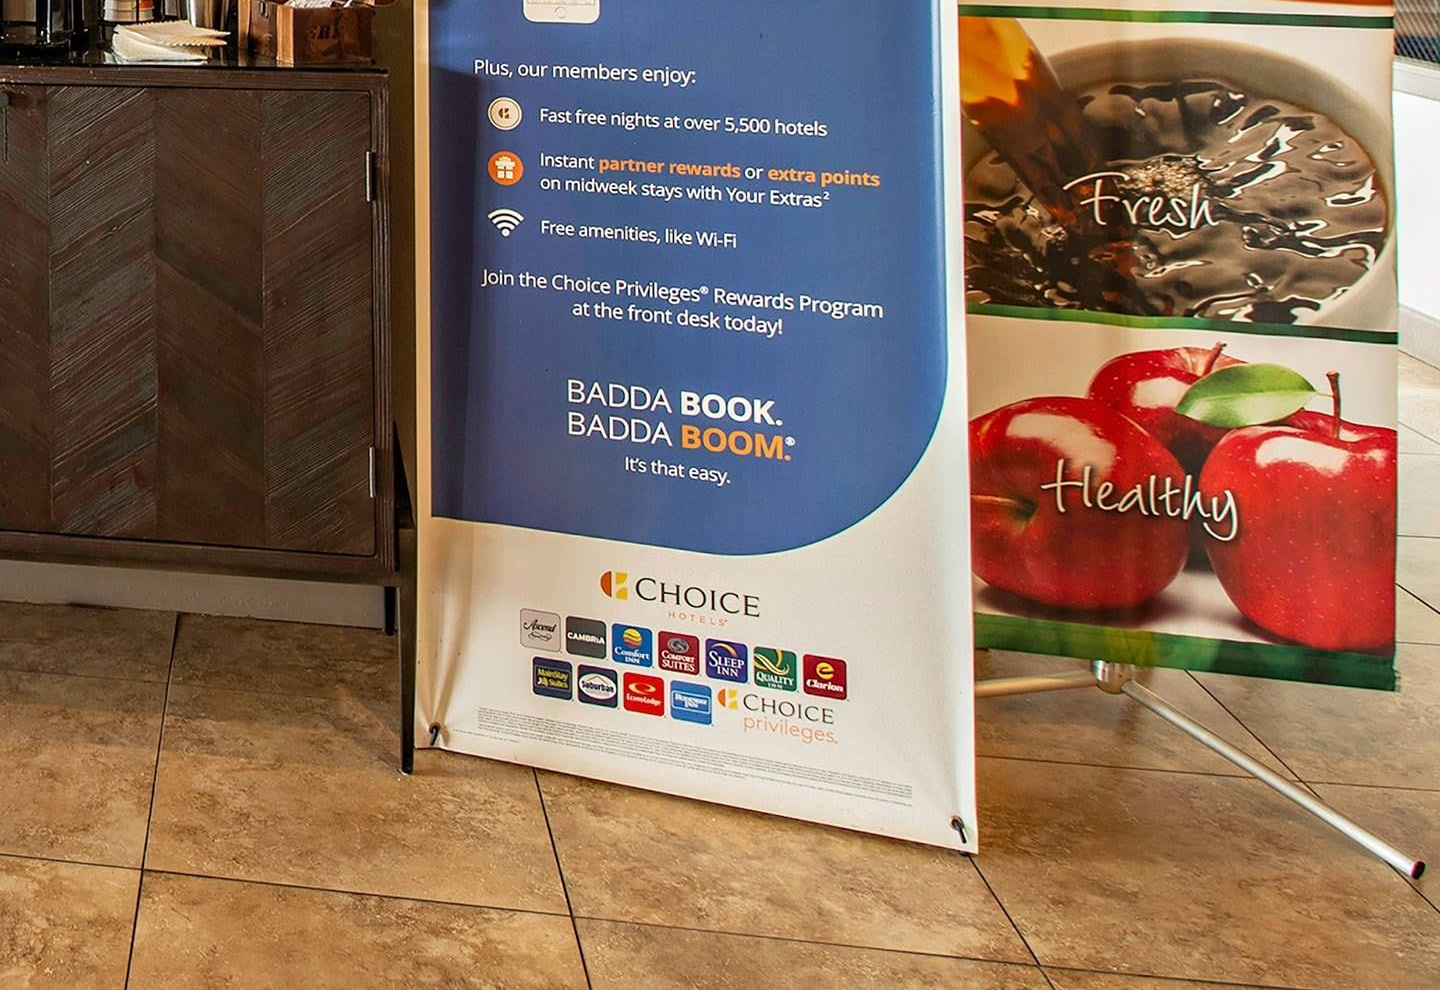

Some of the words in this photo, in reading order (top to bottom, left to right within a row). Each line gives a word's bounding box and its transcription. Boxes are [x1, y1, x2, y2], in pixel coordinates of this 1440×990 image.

[474, 59, 512, 77] Plus,
[517, 64, 548, 76] our
[552, 63, 637, 80] members
[642, 66, 695, 87] enjoy:
[540, 108, 571, 123] Fast
[574, 109, 606, 124] free
[610, 111, 659, 130] nights
[663, 115, 680, 128] at
[683, 117, 721, 130] over
[724, 116, 770, 133] 5,500
[774, 118, 827, 136] hotels
[540, 152, 594, 169] Instant
[598, 158, 664, 173] partner
[669, 162, 740, 178] rewards
[744, 167, 763, 179] or
[767, 168, 816, 182] extra
[820, 169, 880, 187] points
[540, 178, 560, 189] on
[565, 177, 637, 195] midweek
[641, 183, 682, 201] stays
[685, 185, 721, 200] with
[725, 186, 765, 203] Your
[1062, 172, 1220, 229] Fresh
[541, 220, 574, 235] Free
[578, 225, 660, 244] amenities,
[665, 228, 692, 244] like
[695, 231, 736, 248] Wi-Fi
[481, 269, 514, 286] Join
[518, 271, 547, 288] the
[551, 274, 610, 294] Choice
[714, 287, 794, 310] Rewards
[799, 295, 883, 319] Program
[572, 302, 589, 316] at
[593, 301, 623, 319] the
[627, 304, 672, 324] front
[676, 309, 720, 328] desk
[724, 314, 782, 338] today!
[567, 379, 672, 413] BADDA
[680, 391, 783, 426] BOOK.
[568, 411, 672, 446] BADDA
[650, 459, 684, 477] that
[688, 467, 730, 486] easy.
[1041, 457, 1239, 542] Healthy
[635, 576, 760, 618] CHOICE
[523, 618, 557, 633] Ascend
[668, 610, 727, 627] HOTELS
[614, 646, 650, 660] Comfort
[625, 656, 641, 664] INN
[660, 649, 697, 666] COMFORT
[661, 658, 697, 674] SUITES
[708, 650, 745, 669] SLEEP
[537, 668, 569, 681] MainStay
[716, 667, 739, 678] INN
[756, 671, 794, 686] QUALITY
[581, 680, 615, 693] Suburban
[806, 679, 844, 693] Clarion
[743, 693, 835, 725] CHOICE
